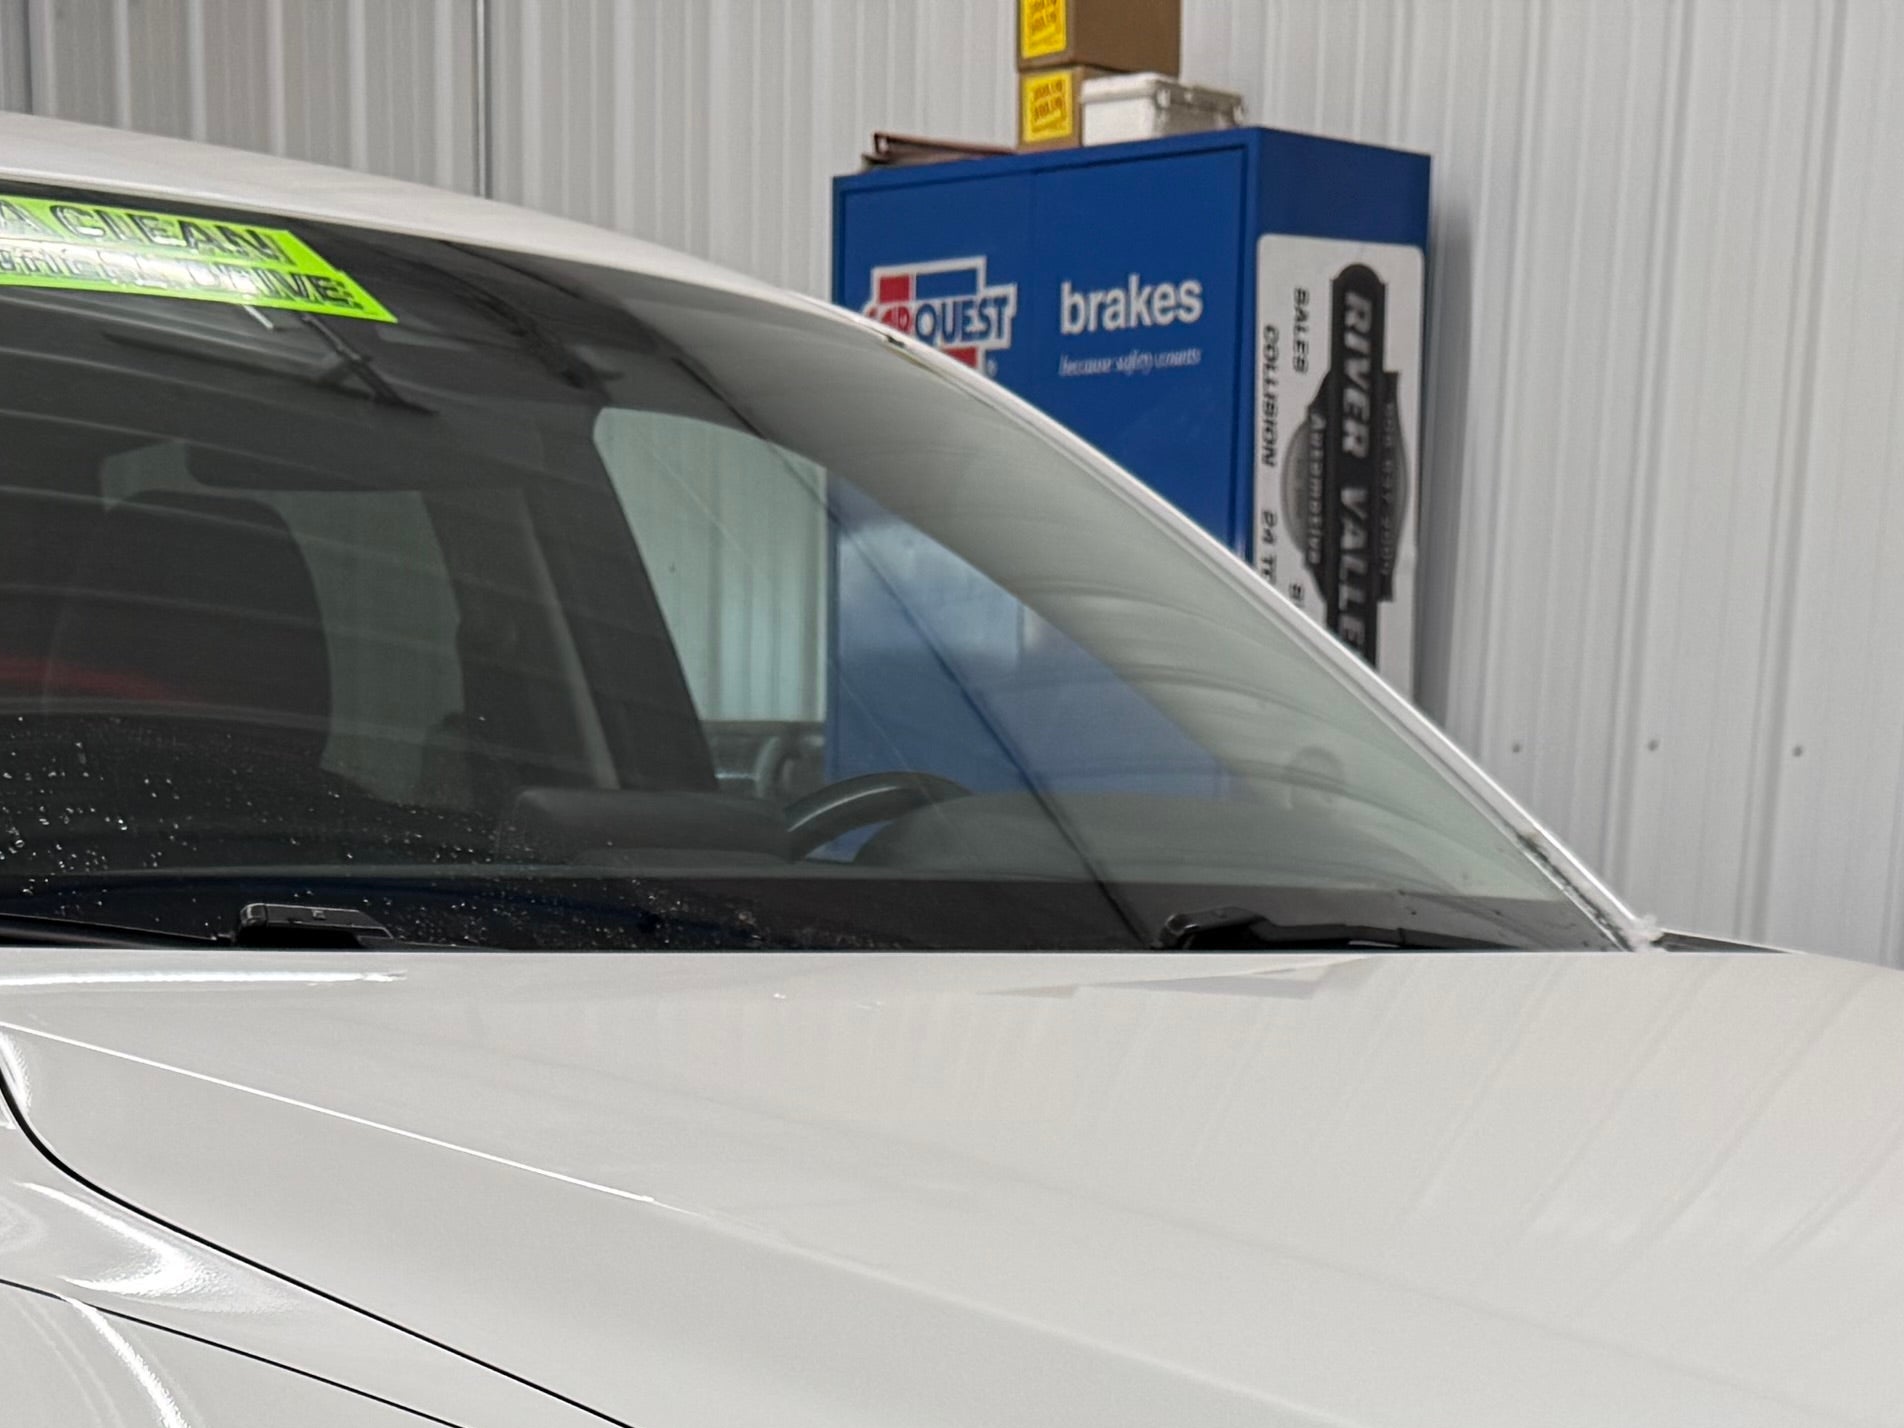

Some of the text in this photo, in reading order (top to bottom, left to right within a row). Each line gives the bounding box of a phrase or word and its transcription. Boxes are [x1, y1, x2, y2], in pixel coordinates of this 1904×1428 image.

[50, 205, 298, 267] CLEAN
[184, 258, 365, 311] DRIVE
[868, 296, 1008, 346] RQUEST
[1060, 273, 1203, 334] brakes
[1293, 286, 1310, 374] SALES
[1260, 323, 1280, 468] COLLISION
[1307, 412, 1327, 566] Automotive
[1337, 291, 1373, 648] RIVER VALLE
